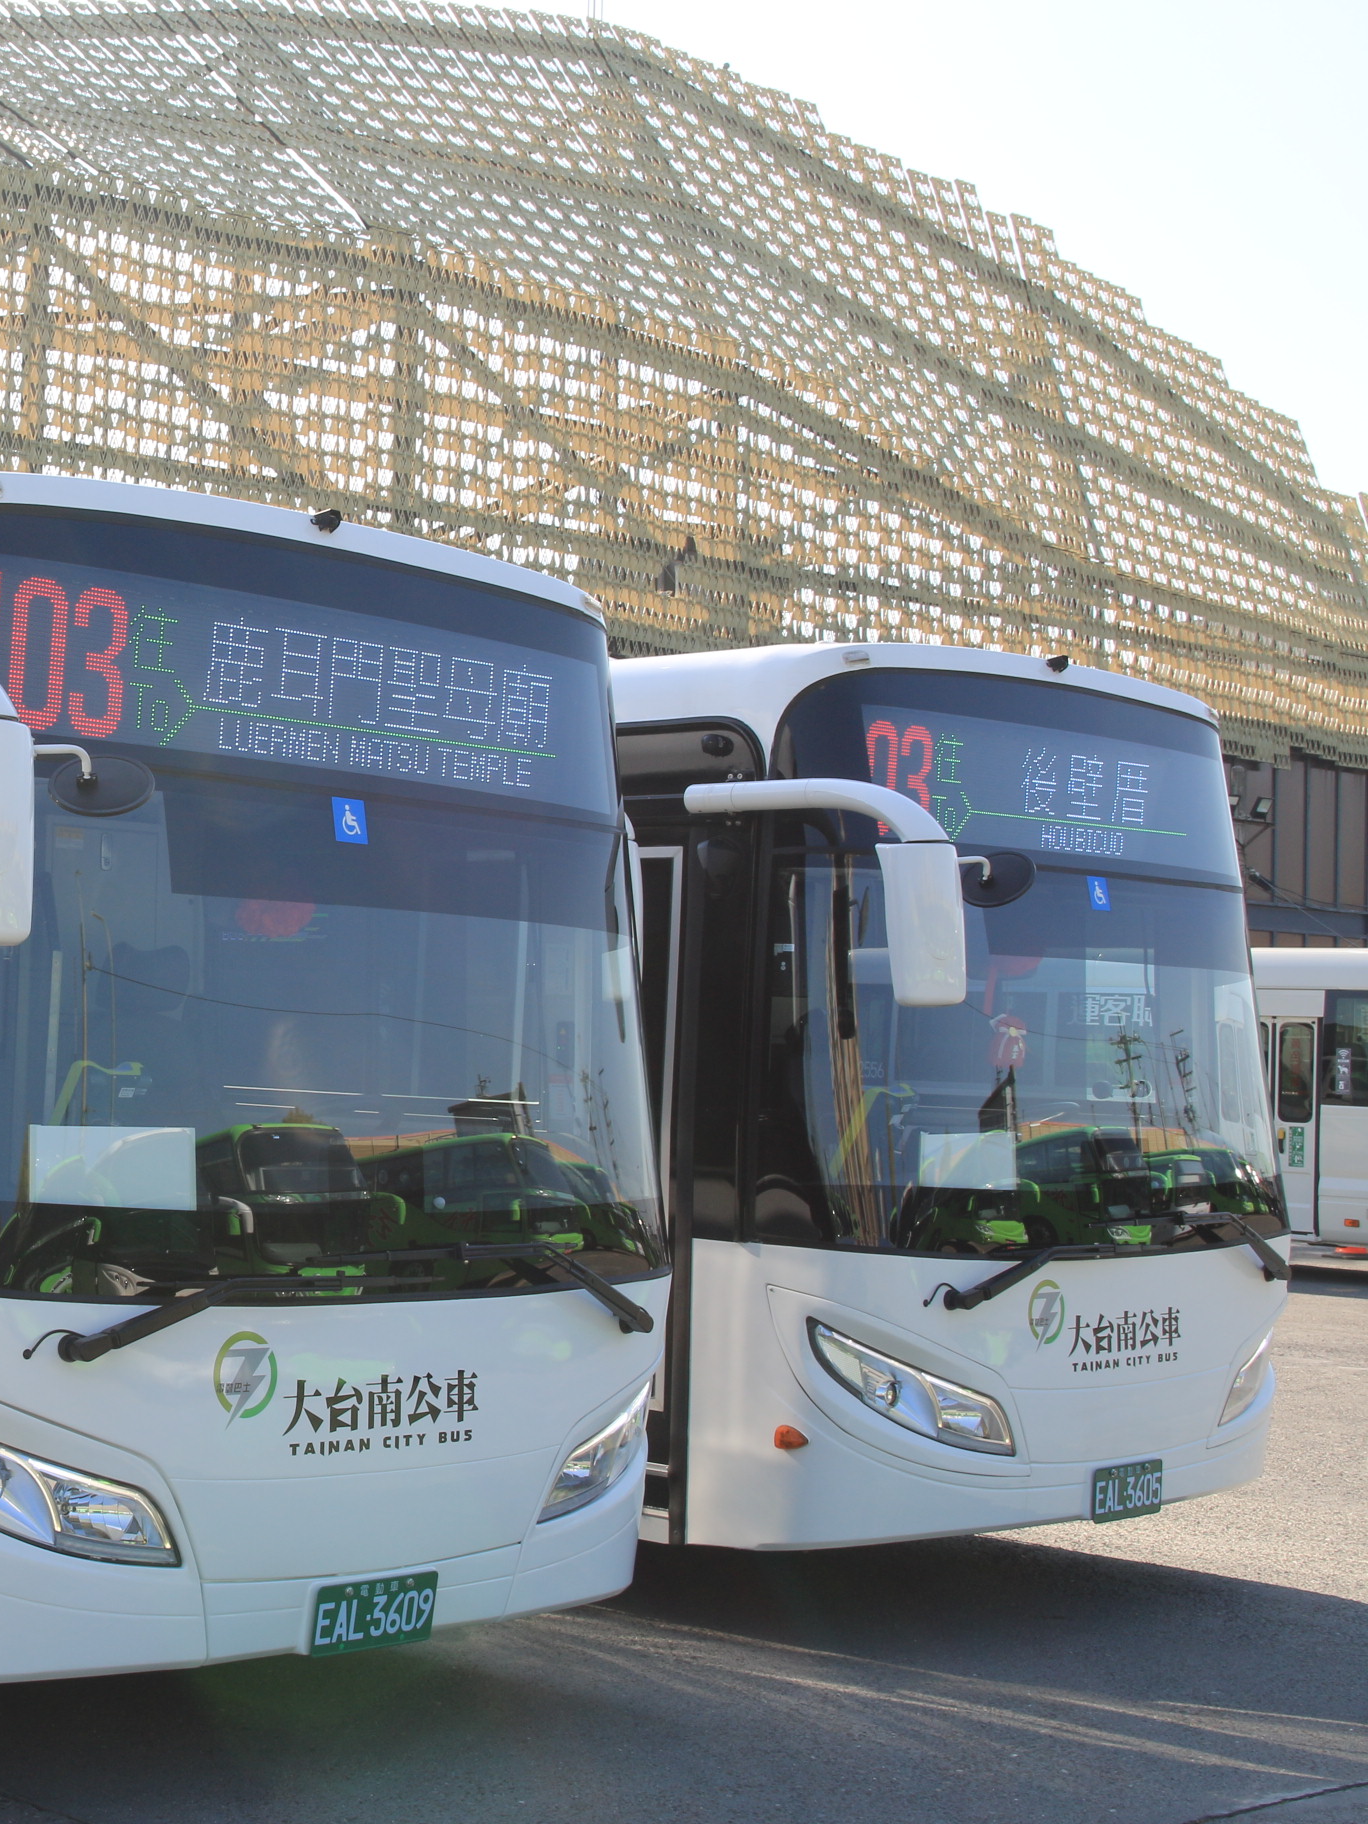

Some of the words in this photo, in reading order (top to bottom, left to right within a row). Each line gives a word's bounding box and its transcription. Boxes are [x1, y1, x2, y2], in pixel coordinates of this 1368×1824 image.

[129, 605, 178, 673] 往
[130, 682, 169, 732] To
[203, 617, 553, 748] 鹿耳門聖母廟
[219, 718, 339, 763] LUERMEN
[350, 736, 431, 775] MATSU
[437, 747, 532, 788] TEMPLE
[934, 733, 964, 784] 往
[1021, 747, 1150, 826] 後壁厝
[932, 795, 957, 832] To
[1040, 824, 1125, 856] HOUBICUO
[1067, 1306, 1181, 1358] 大台南公車
[1072, 1358, 1120, 1373] TAINAN
[1126, 1354, 1151, 1368] CITY
[1158, 1351, 1178, 1363] BUS
[282, 1369, 479, 1437] 大台南公車
[289, 1437, 371, 1457] TAINAN
[382, 1432, 426, 1451] CITY
[438, 1429, 474, 1444] BUS
[360, 1580, 400, 1597] 電動車
[314, 1588, 434, 1646] EAL-3609
